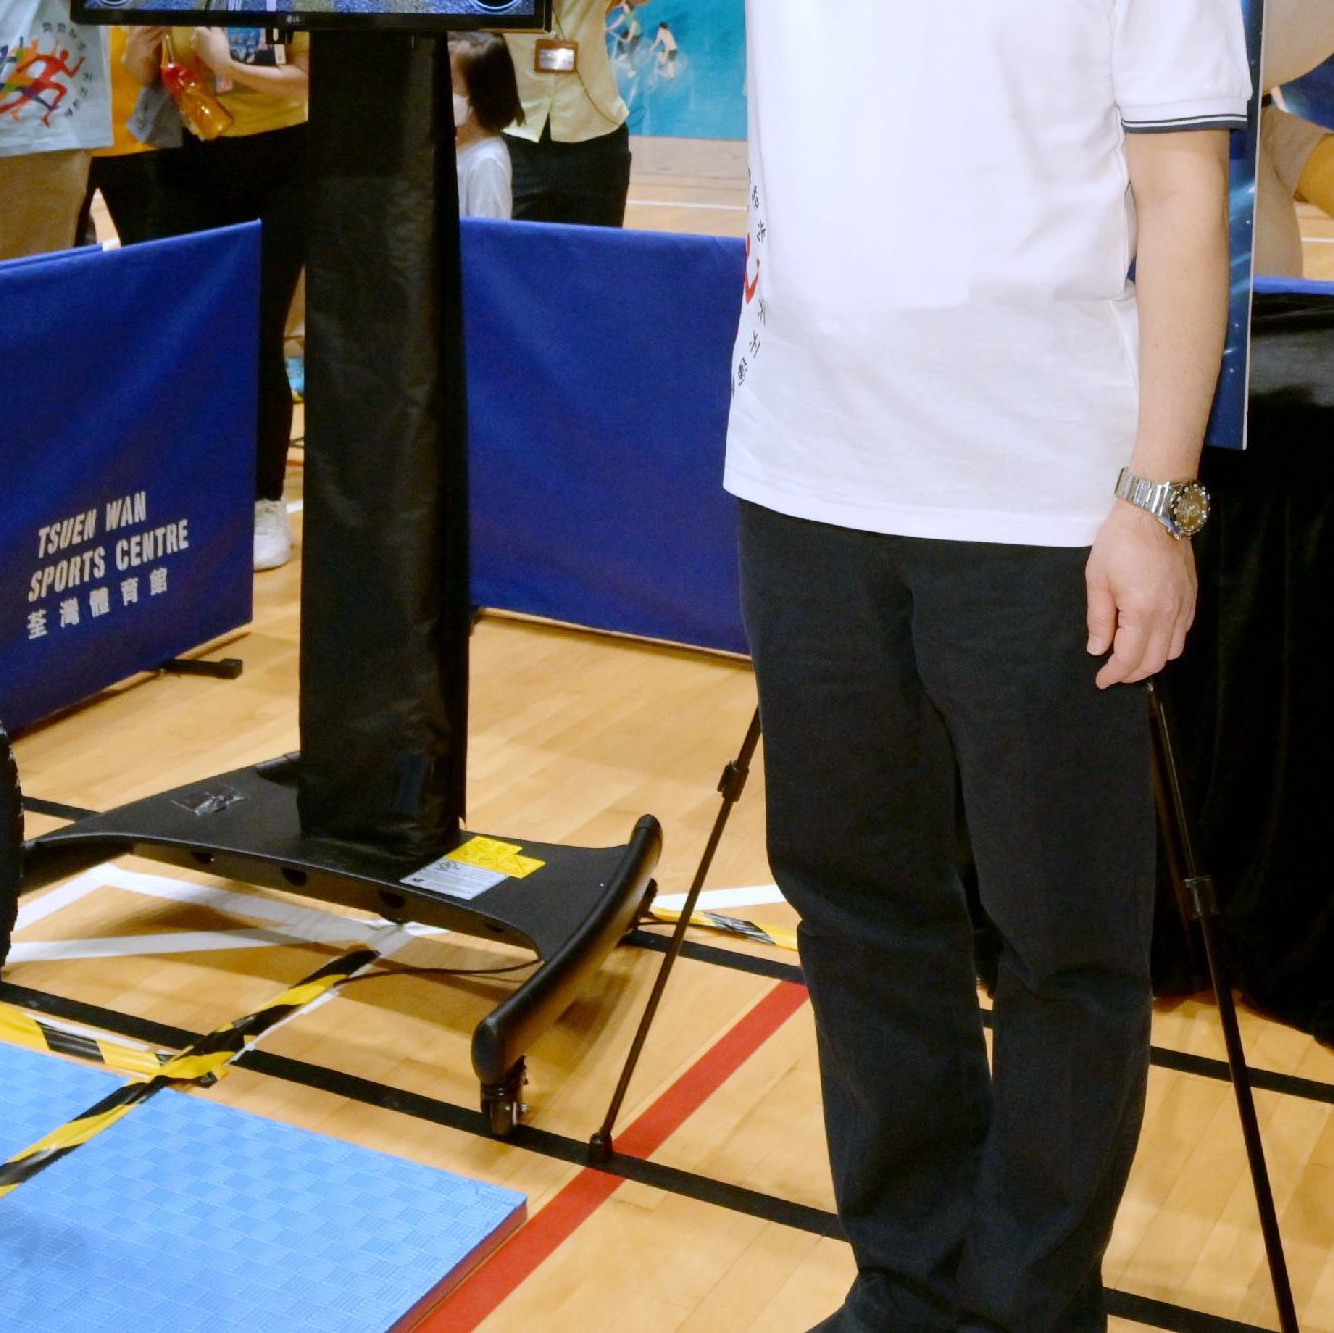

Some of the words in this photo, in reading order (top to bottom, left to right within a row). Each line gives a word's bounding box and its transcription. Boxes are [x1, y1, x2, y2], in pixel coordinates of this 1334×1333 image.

[28, 546, 106, 603] SPORTS
[116, 518, 189, 572] CENTRE
[38, 509, 97, 559] TSUEN
[106, 490, 147, 532] WAN
